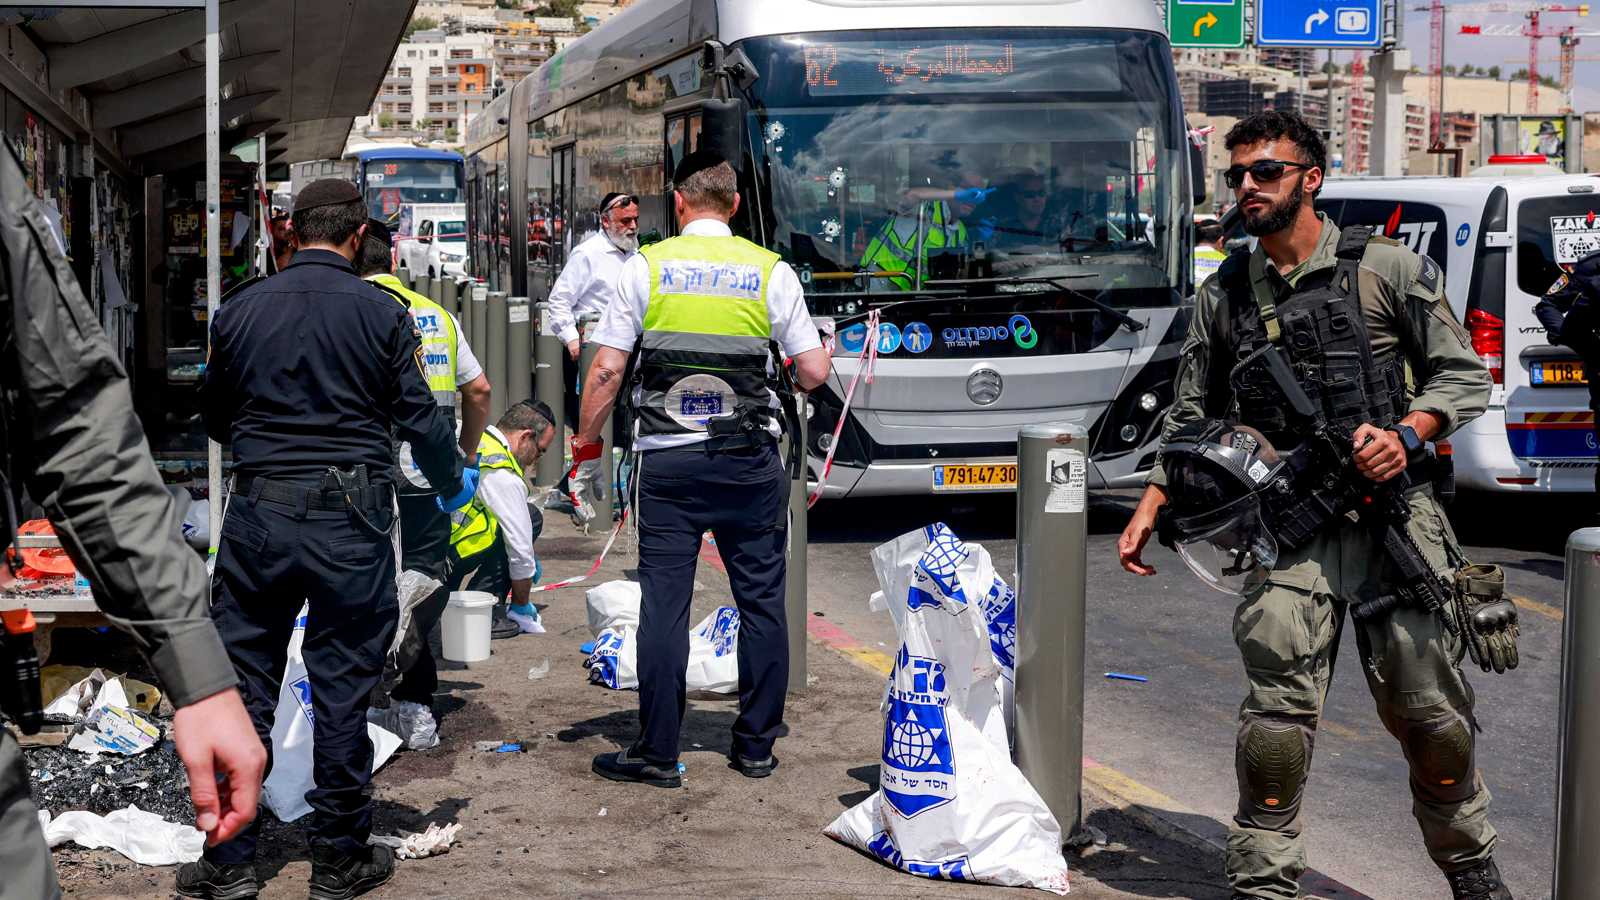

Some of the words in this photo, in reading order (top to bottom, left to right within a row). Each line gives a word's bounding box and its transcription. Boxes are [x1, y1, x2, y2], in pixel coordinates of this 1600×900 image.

[1349, 15, 1356, 27] 1
[901, 772, 919, 788] של
[925, 779, 948, 790] חסד
